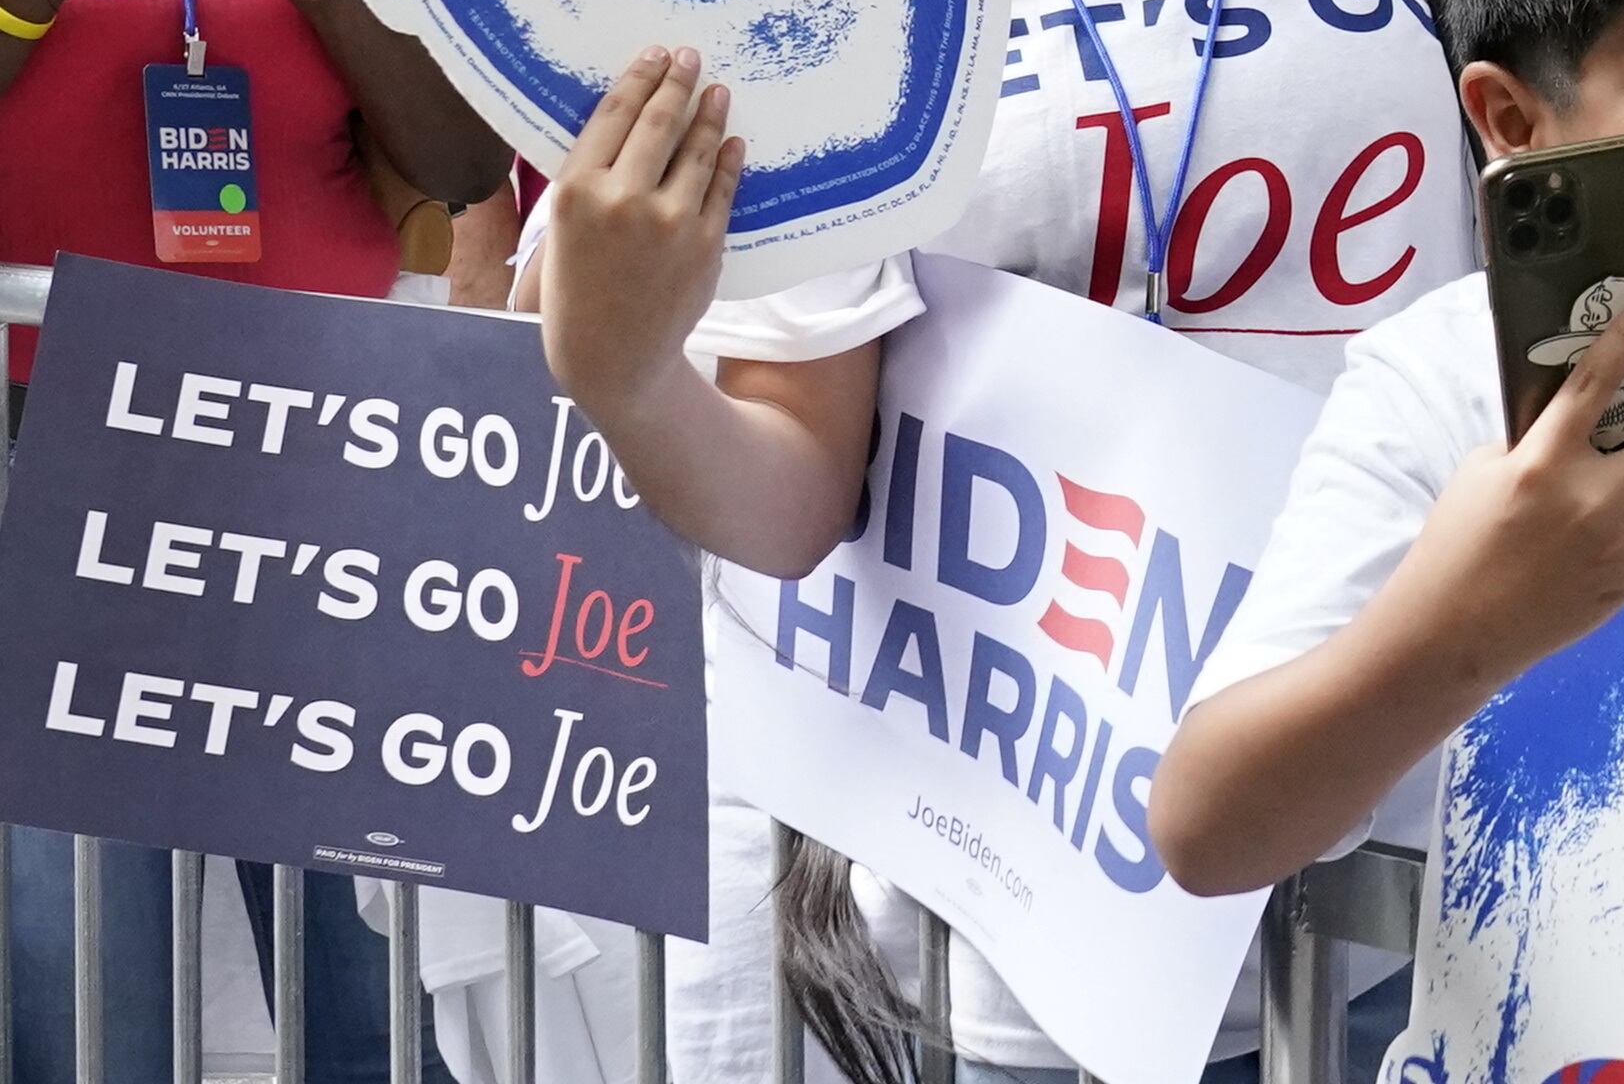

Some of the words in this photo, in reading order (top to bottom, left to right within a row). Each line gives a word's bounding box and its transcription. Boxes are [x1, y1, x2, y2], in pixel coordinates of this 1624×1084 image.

[160, 127, 247, 150] BIDEN
[162, 152, 250, 171] HARRIS
[800, 166, 877, 195] TRANSPORTATION
[914, 111, 932, 143] PLACE
[173, 225, 251, 236] VOLUNTEER
[1076, 101, 1426, 314] Joe
[106, 361, 401, 469] LET'S
[419, 406, 519, 487] GO
[75, 510, 381, 620] LET'S
[403, 559, 519, 641] GO
[521, 553, 656, 678] Joe
[852, 409, 1254, 724] IDEN
[45, 660, 357, 773] LET'S
[381, 712, 512, 796] GO
[512, 708, 658, 833] Joe
[775, 574, 1167, 895] HARRIS
[315, 849, 336, 859] PAID
[357, 855, 382, 865] BIDEN
[382, 857, 400, 867] FOR
[400, 860, 443, 874] PRESIDENT
[907, 795, 1034, 914] JoeBiden.com
